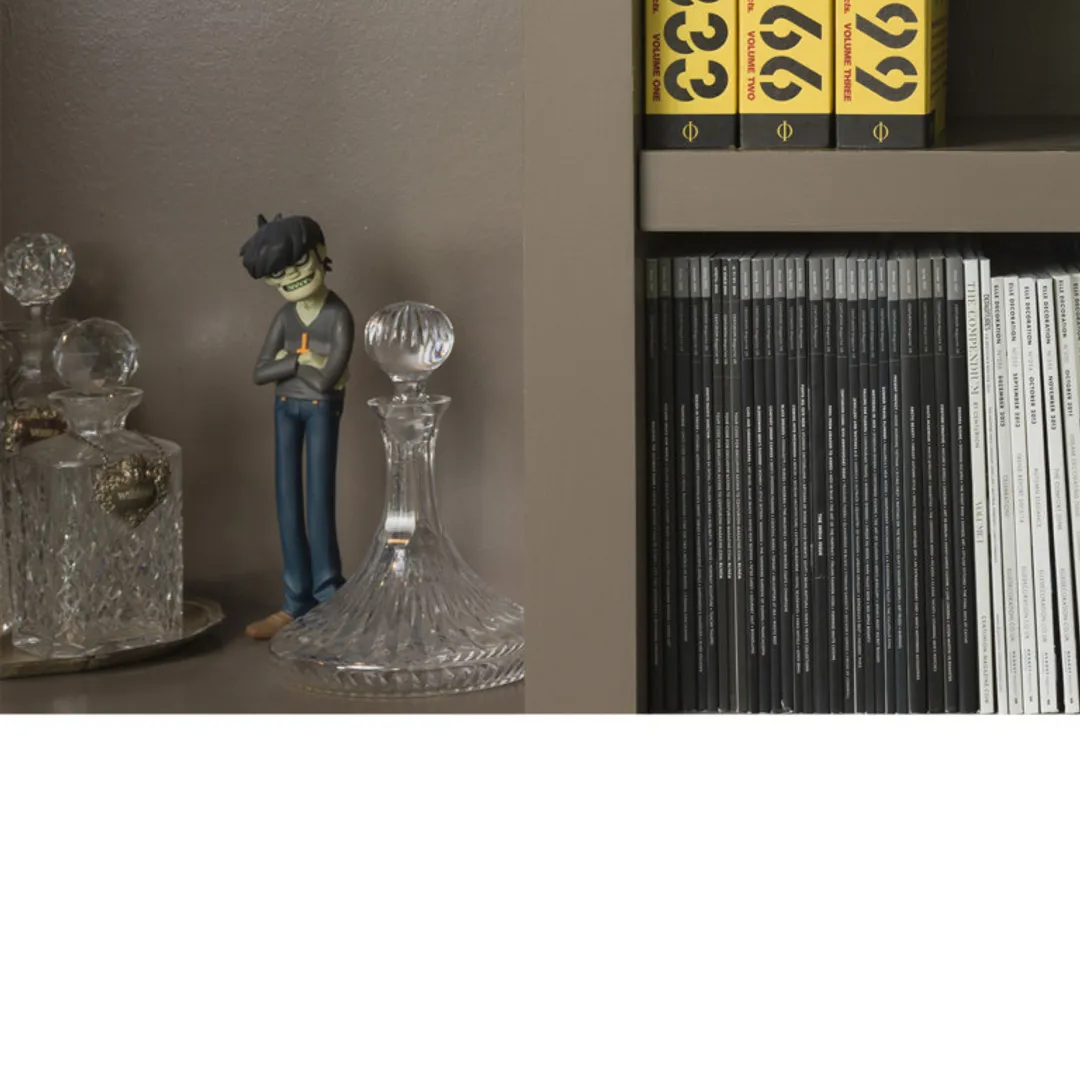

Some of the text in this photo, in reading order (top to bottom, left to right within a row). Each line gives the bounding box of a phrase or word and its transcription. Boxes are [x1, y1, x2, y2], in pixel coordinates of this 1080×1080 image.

[651, 34, 660, 76] VOLUME
[747, 31, 756, 73] VOLUME
[843, 23, 852, 66] VOLUME
[651, 79, 660, 102] ONE
[747, 76, 756, 100] TWO
[843, 69, 852, 102] THREE
[967, 282, 976, 306] THE
[968, 310, 978, 395] COMPENDIUM
